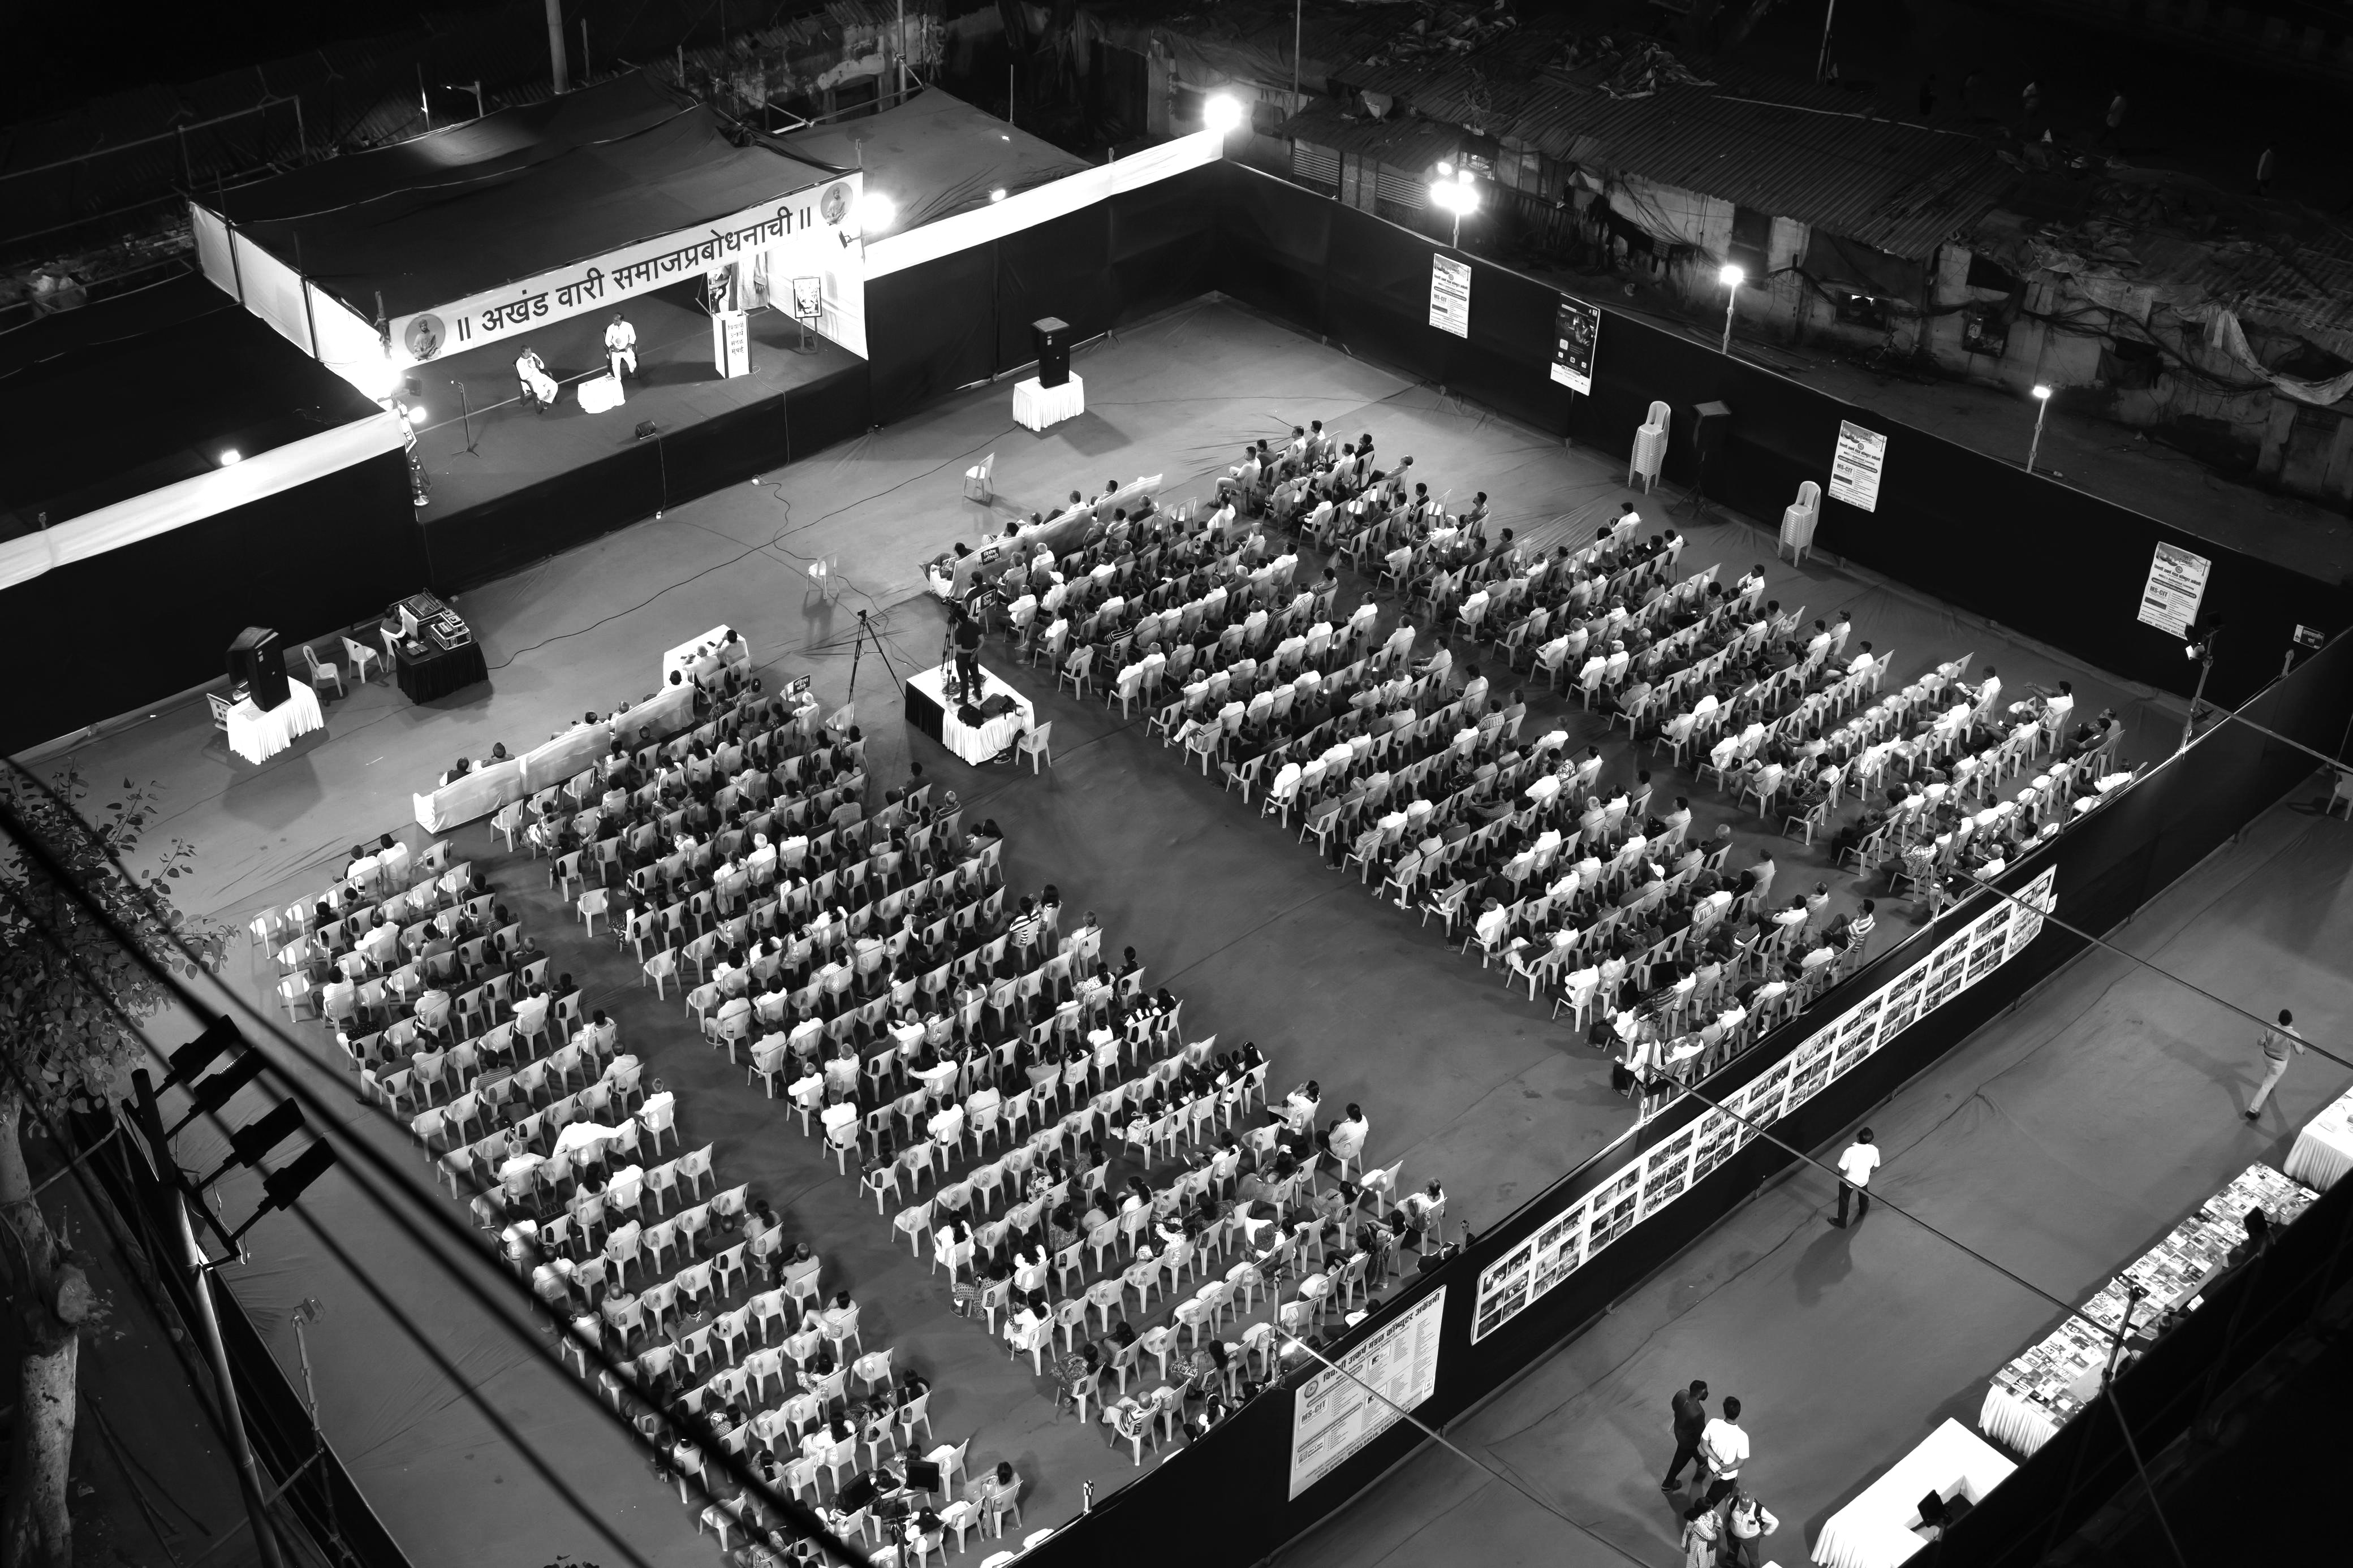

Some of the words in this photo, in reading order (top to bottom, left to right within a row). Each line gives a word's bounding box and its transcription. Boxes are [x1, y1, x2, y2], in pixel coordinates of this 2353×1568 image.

[482, 290, 548, 331] अखंड
[556, 266, 604, 306] वारी
[612, 206, 793, 290] समाजप्रबोधनाची
[1348, 1344, 1367, 1364] उत्कर्ष
[1368, 1330, 1385, 1350] मंडळ
[1302, 1399, 1326, 1423] MS-CIT
[1348, 1442, 1362, 1457] 90763
